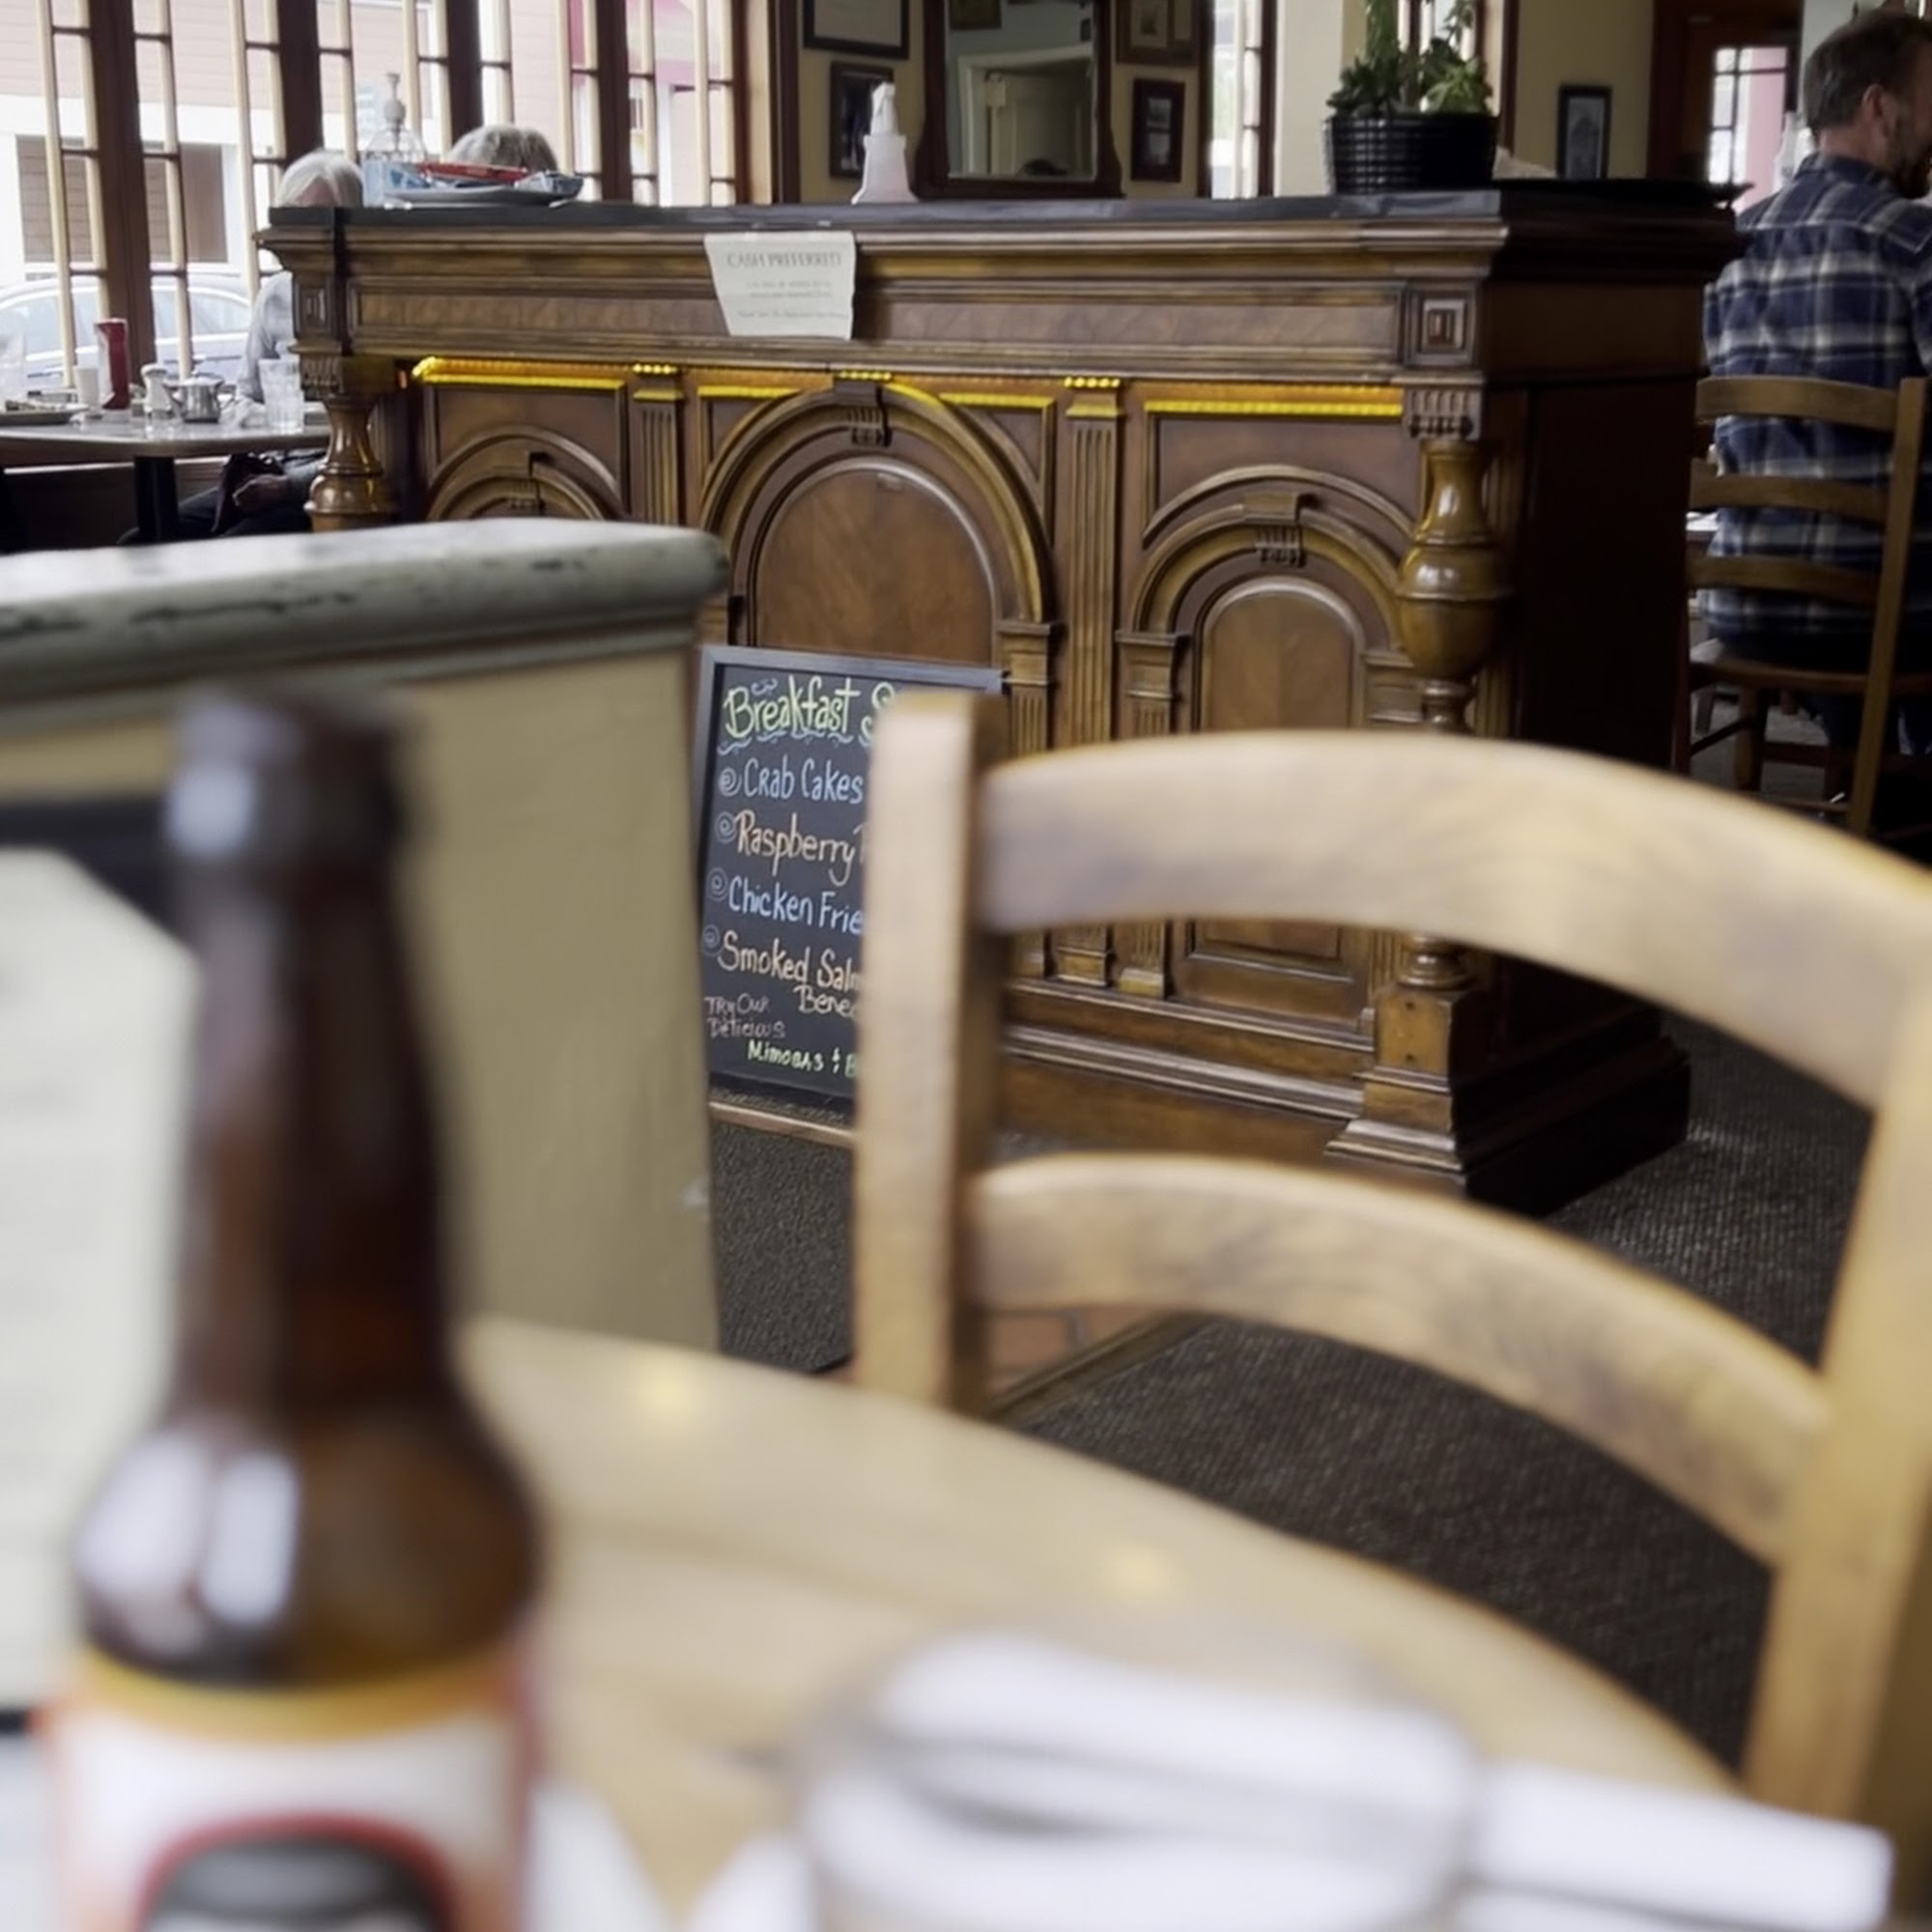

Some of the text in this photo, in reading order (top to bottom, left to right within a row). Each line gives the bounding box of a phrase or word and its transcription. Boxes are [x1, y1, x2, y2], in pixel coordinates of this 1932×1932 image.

[724, 674, 861, 738] Breakfast
[801, 757, 864, 805] Cakes
[734, 810, 856, 886] Raspberry
[728, 875, 812, 926] Chicken
[717, 929, 811, 983] Smoked
